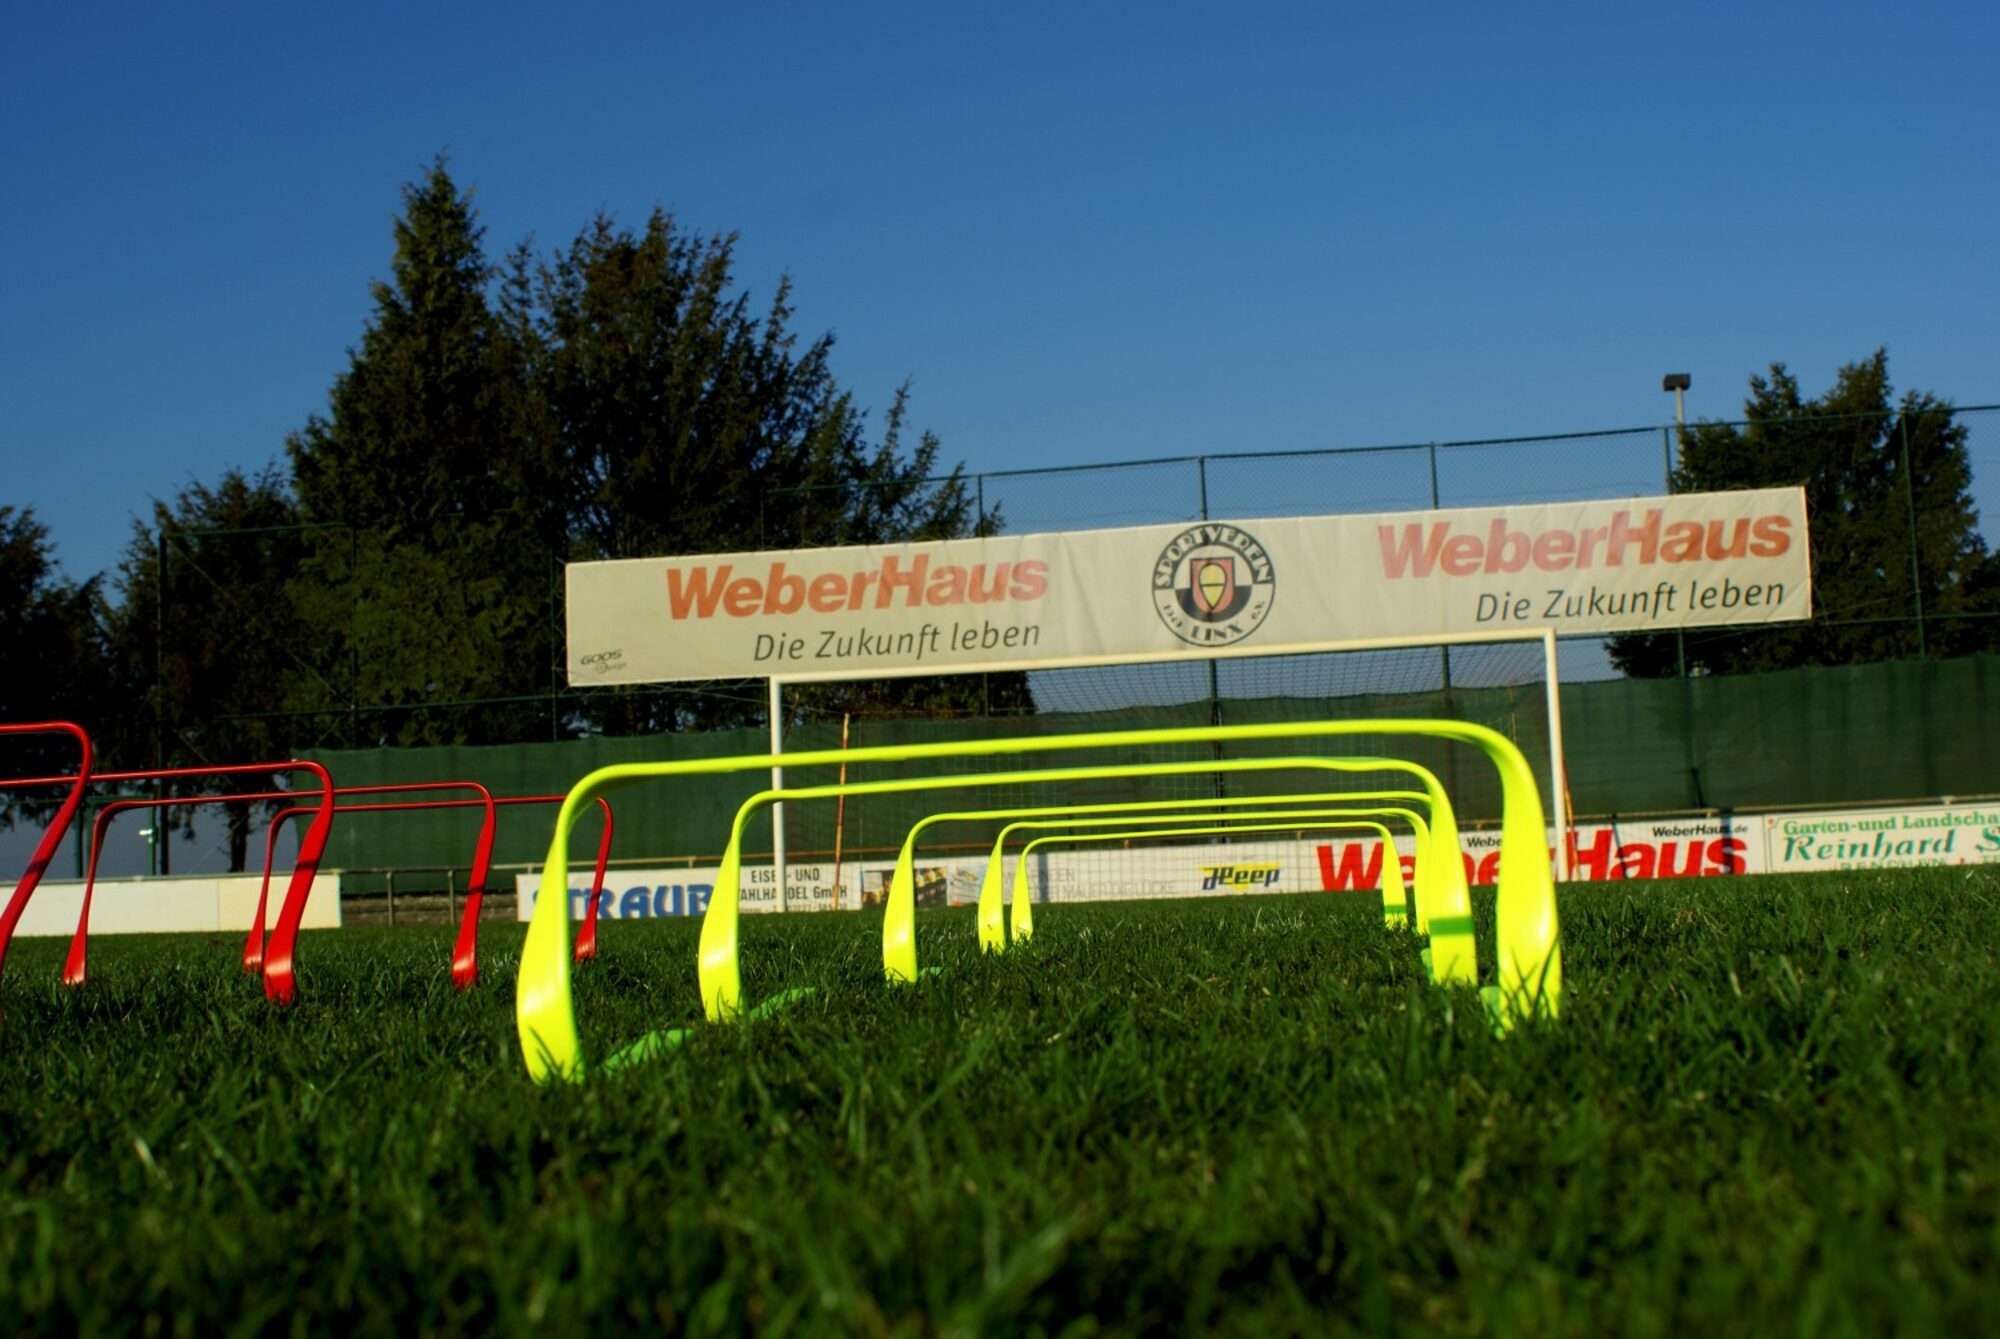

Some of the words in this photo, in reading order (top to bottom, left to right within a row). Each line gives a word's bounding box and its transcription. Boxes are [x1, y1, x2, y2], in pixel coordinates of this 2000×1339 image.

[1155, 526, 1272, 588] SPORTVEREIN
[1378, 508, 1792, 579] WeberHaus
[667, 553, 1049, 620] WeberHaus
[1475, 593, 1532, 623] Die
[1544, 582, 1677, 620] Zukunft
[1689, 578, 1784, 611] leben
[753, 633, 805, 662] Die
[815, 624, 941, 661] Zukunft
[951, 620, 1040, 651] leben
[1783, 828, 1956, 862] Reinhard
[795, 867, 820, 881] UND
[813, 885, 848, 899] GmH
[533, 884, 715, 919] TRAUB
